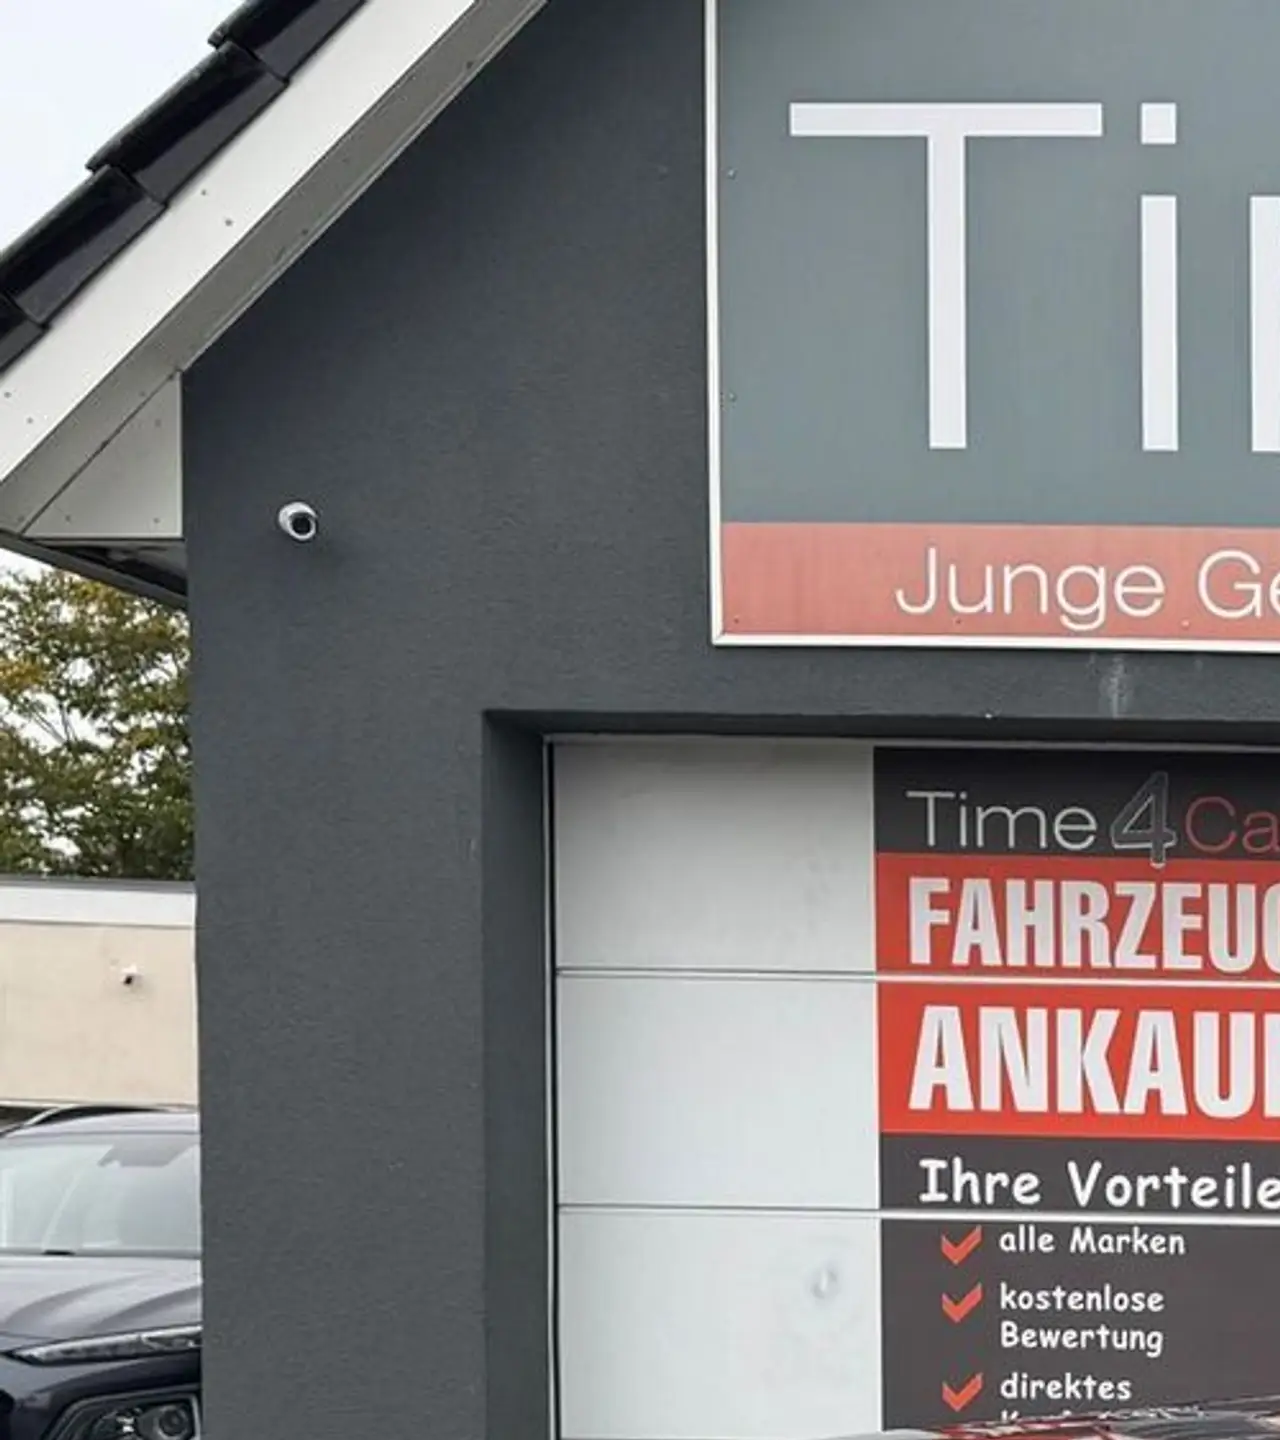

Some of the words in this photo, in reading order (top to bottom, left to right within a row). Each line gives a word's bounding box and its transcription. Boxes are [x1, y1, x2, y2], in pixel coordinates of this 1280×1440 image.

[896, 547, 1165, 622] Junge
[919, 1156, 1041, 1205] Ihre
[999, 1223, 1055, 1253] alle
[1069, 1225, 1186, 1255] Marken
[1000, 1281, 1164, 1313] kostenlose
[1000, 1321, 1164, 1359] Bewertung
[1000, 1371, 1132, 1401] direktes
